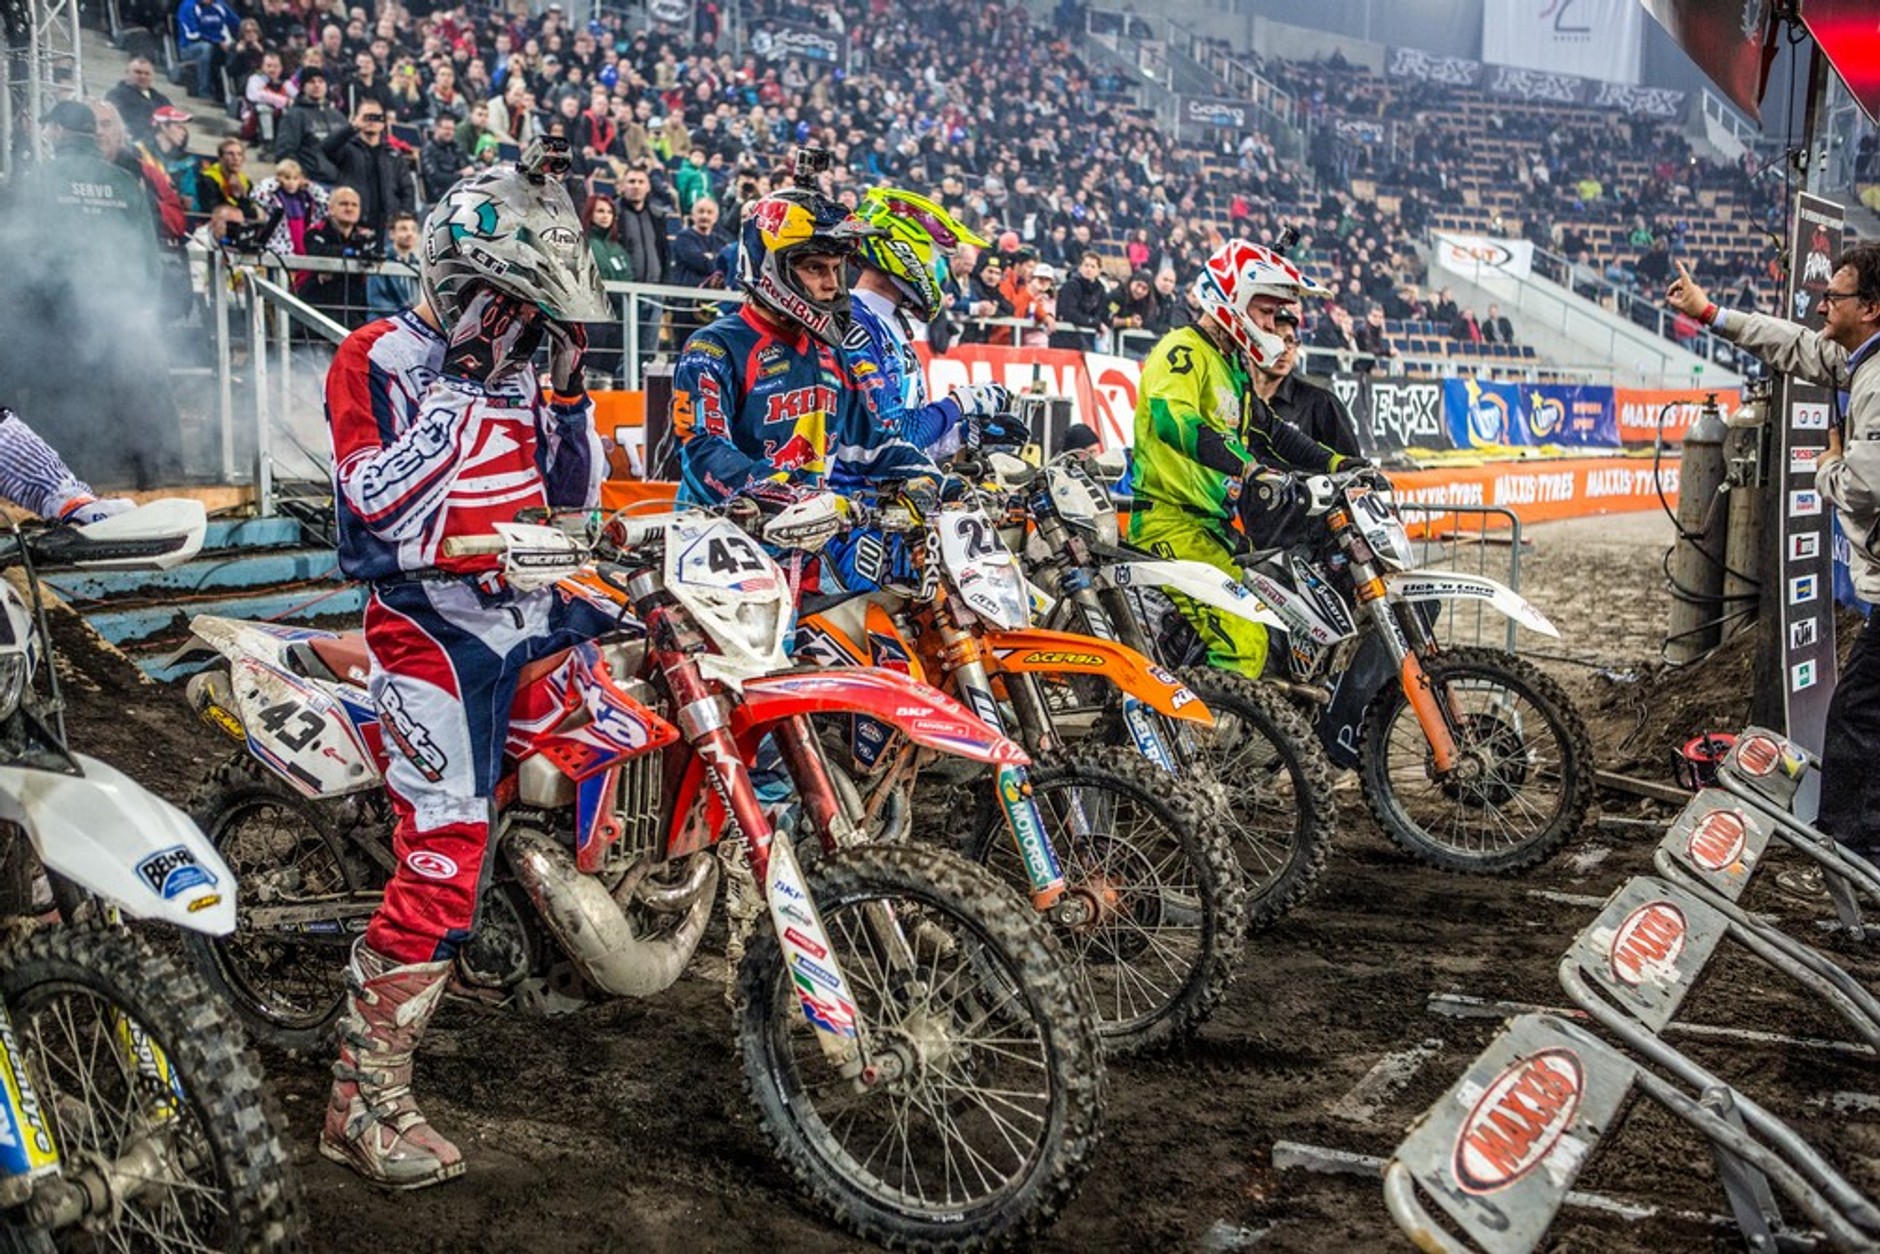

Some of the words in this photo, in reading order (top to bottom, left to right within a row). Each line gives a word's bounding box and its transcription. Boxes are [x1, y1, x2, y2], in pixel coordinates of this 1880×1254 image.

[760, 275, 791, 309] Red
[790, 300, 831, 332] Bull
[1371, 383, 1440, 446] FOX
[361, 407, 457, 501] Beta
[1587, 470, 1631, 497] MAXXIS
[1494, 477, 1536, 505] MAXXIS
[1536, 472, 1575, 501] TYRES
[706, 535, 766, 575] 43
[1024, 652, 1105, 667] ACERBIS
[257, 700, 327, 754] 43
[378, 681, 449, 774] Beta
[1009, 802, 1051, 882] MOTOREX
[1614, 907, 1684, 971] MAXXIS
[1465, 1056, 1578, 1176] MAXXIS
